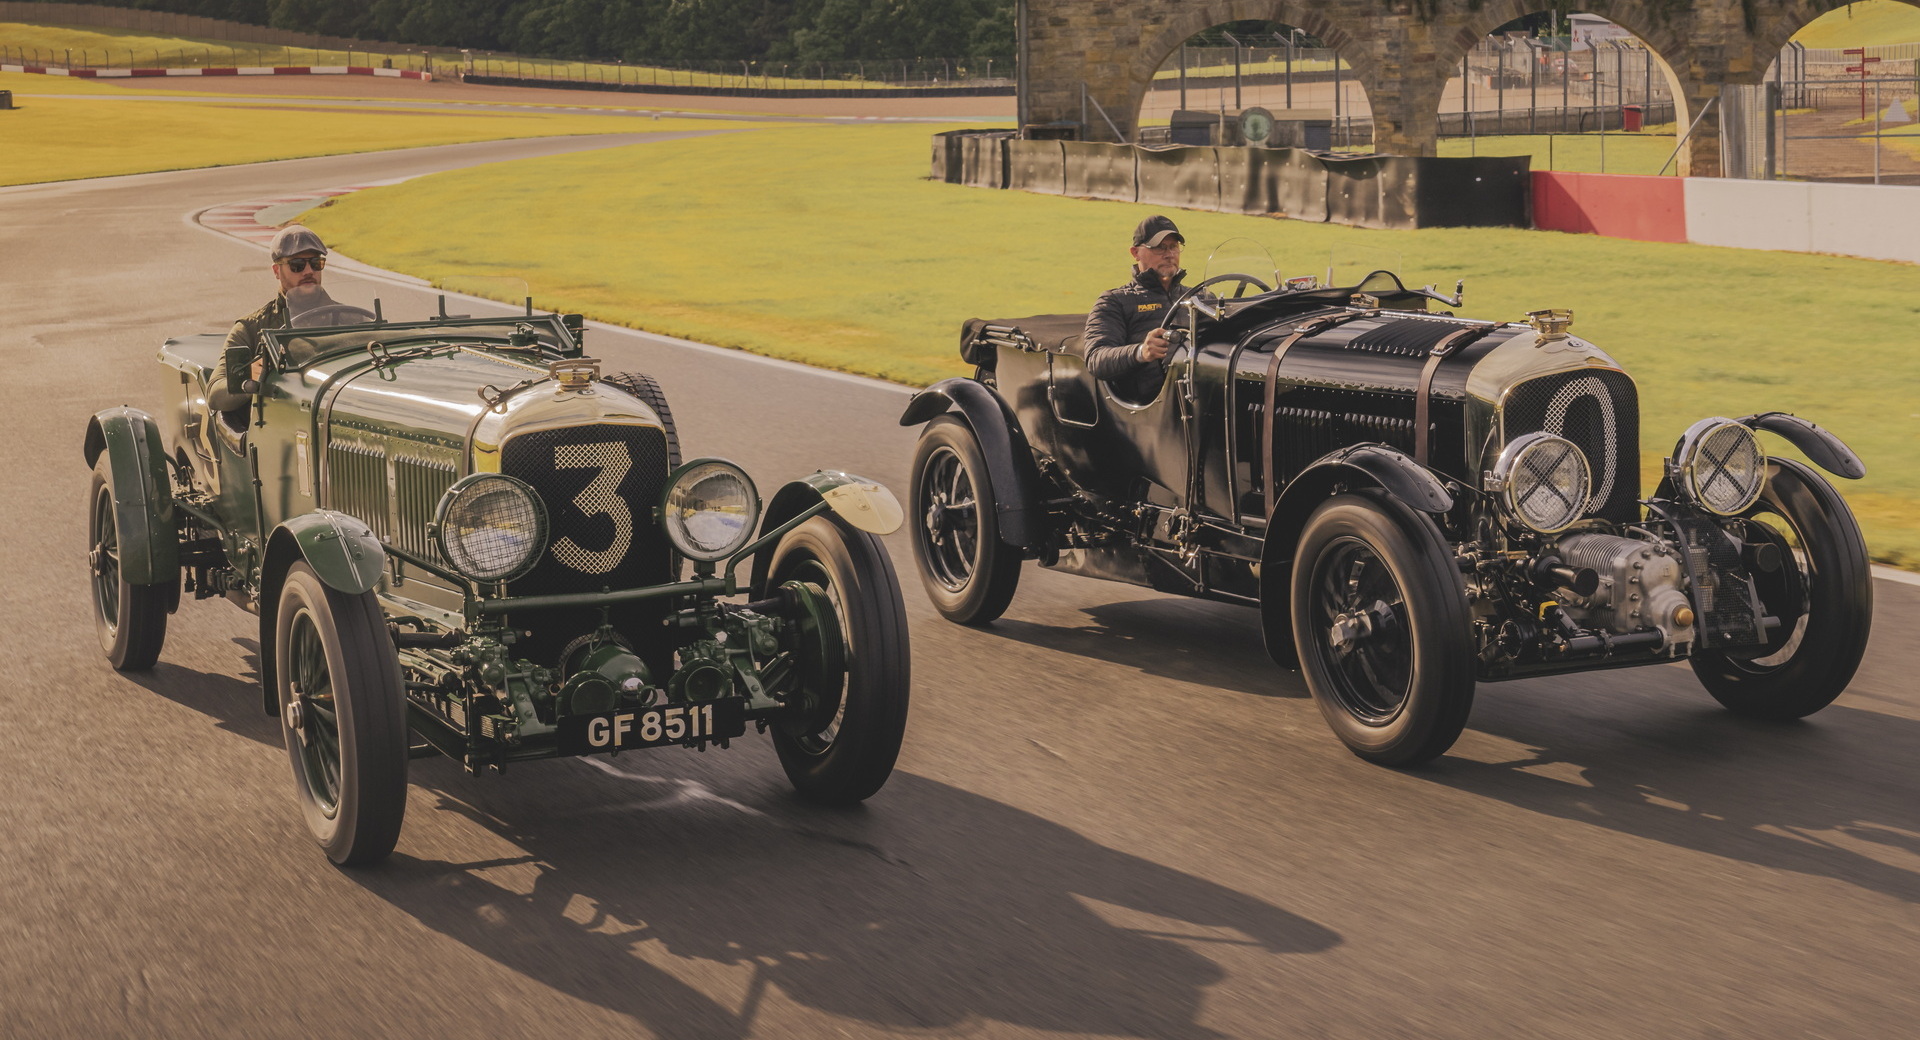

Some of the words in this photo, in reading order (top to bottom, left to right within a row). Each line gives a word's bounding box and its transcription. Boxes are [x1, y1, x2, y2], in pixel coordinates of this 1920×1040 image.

[551, 441, 633, 575] 3
[588, 713, 635, 747] GF
[641, 704, 713, 742] 8511
